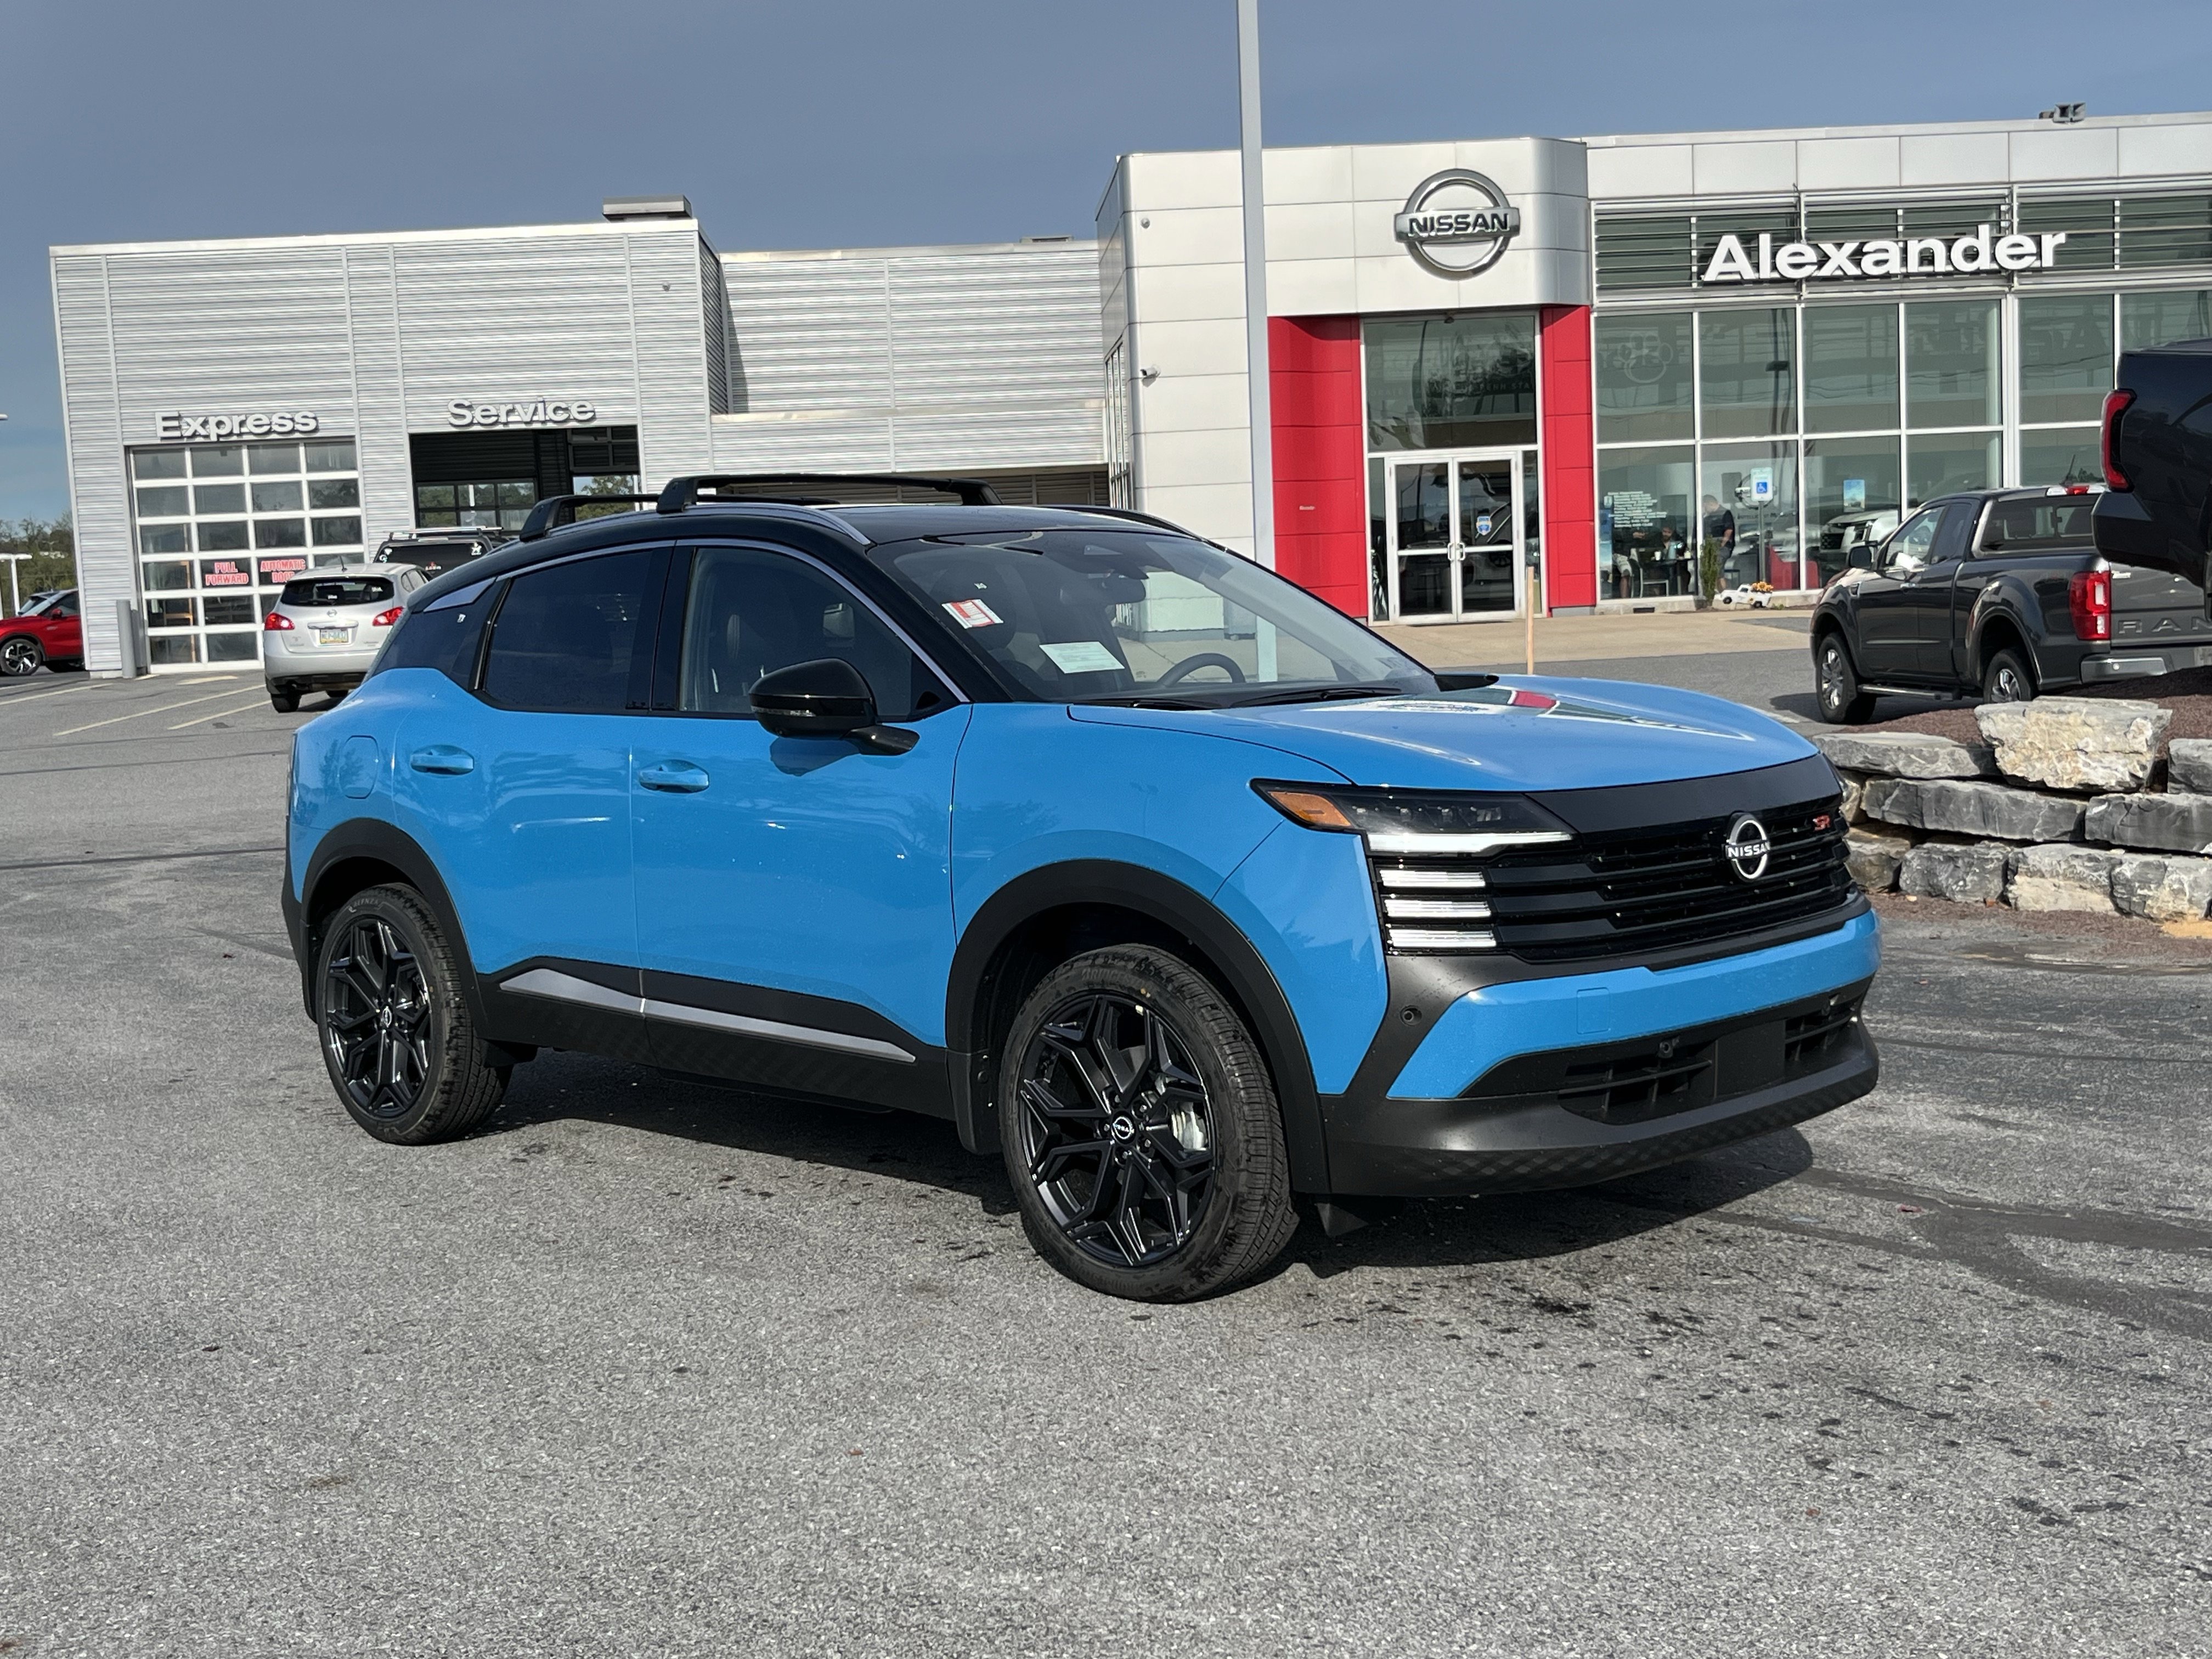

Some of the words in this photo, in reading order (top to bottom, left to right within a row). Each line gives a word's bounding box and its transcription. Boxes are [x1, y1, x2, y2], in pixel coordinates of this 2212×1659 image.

[1408, 212, 1510, 237] NISSAN
[1702, 224, 2066, 281] Alexander
[447, 396, 595, 426] Service
[155, 411, 318, 442] Express
[214, 561, 239, 574] PULL
[260, 558, 307, 572] AUTOMATIC
[205, 573, 249, 586] FORWARD
[1728, 841, 1770, 857] NISSAN
